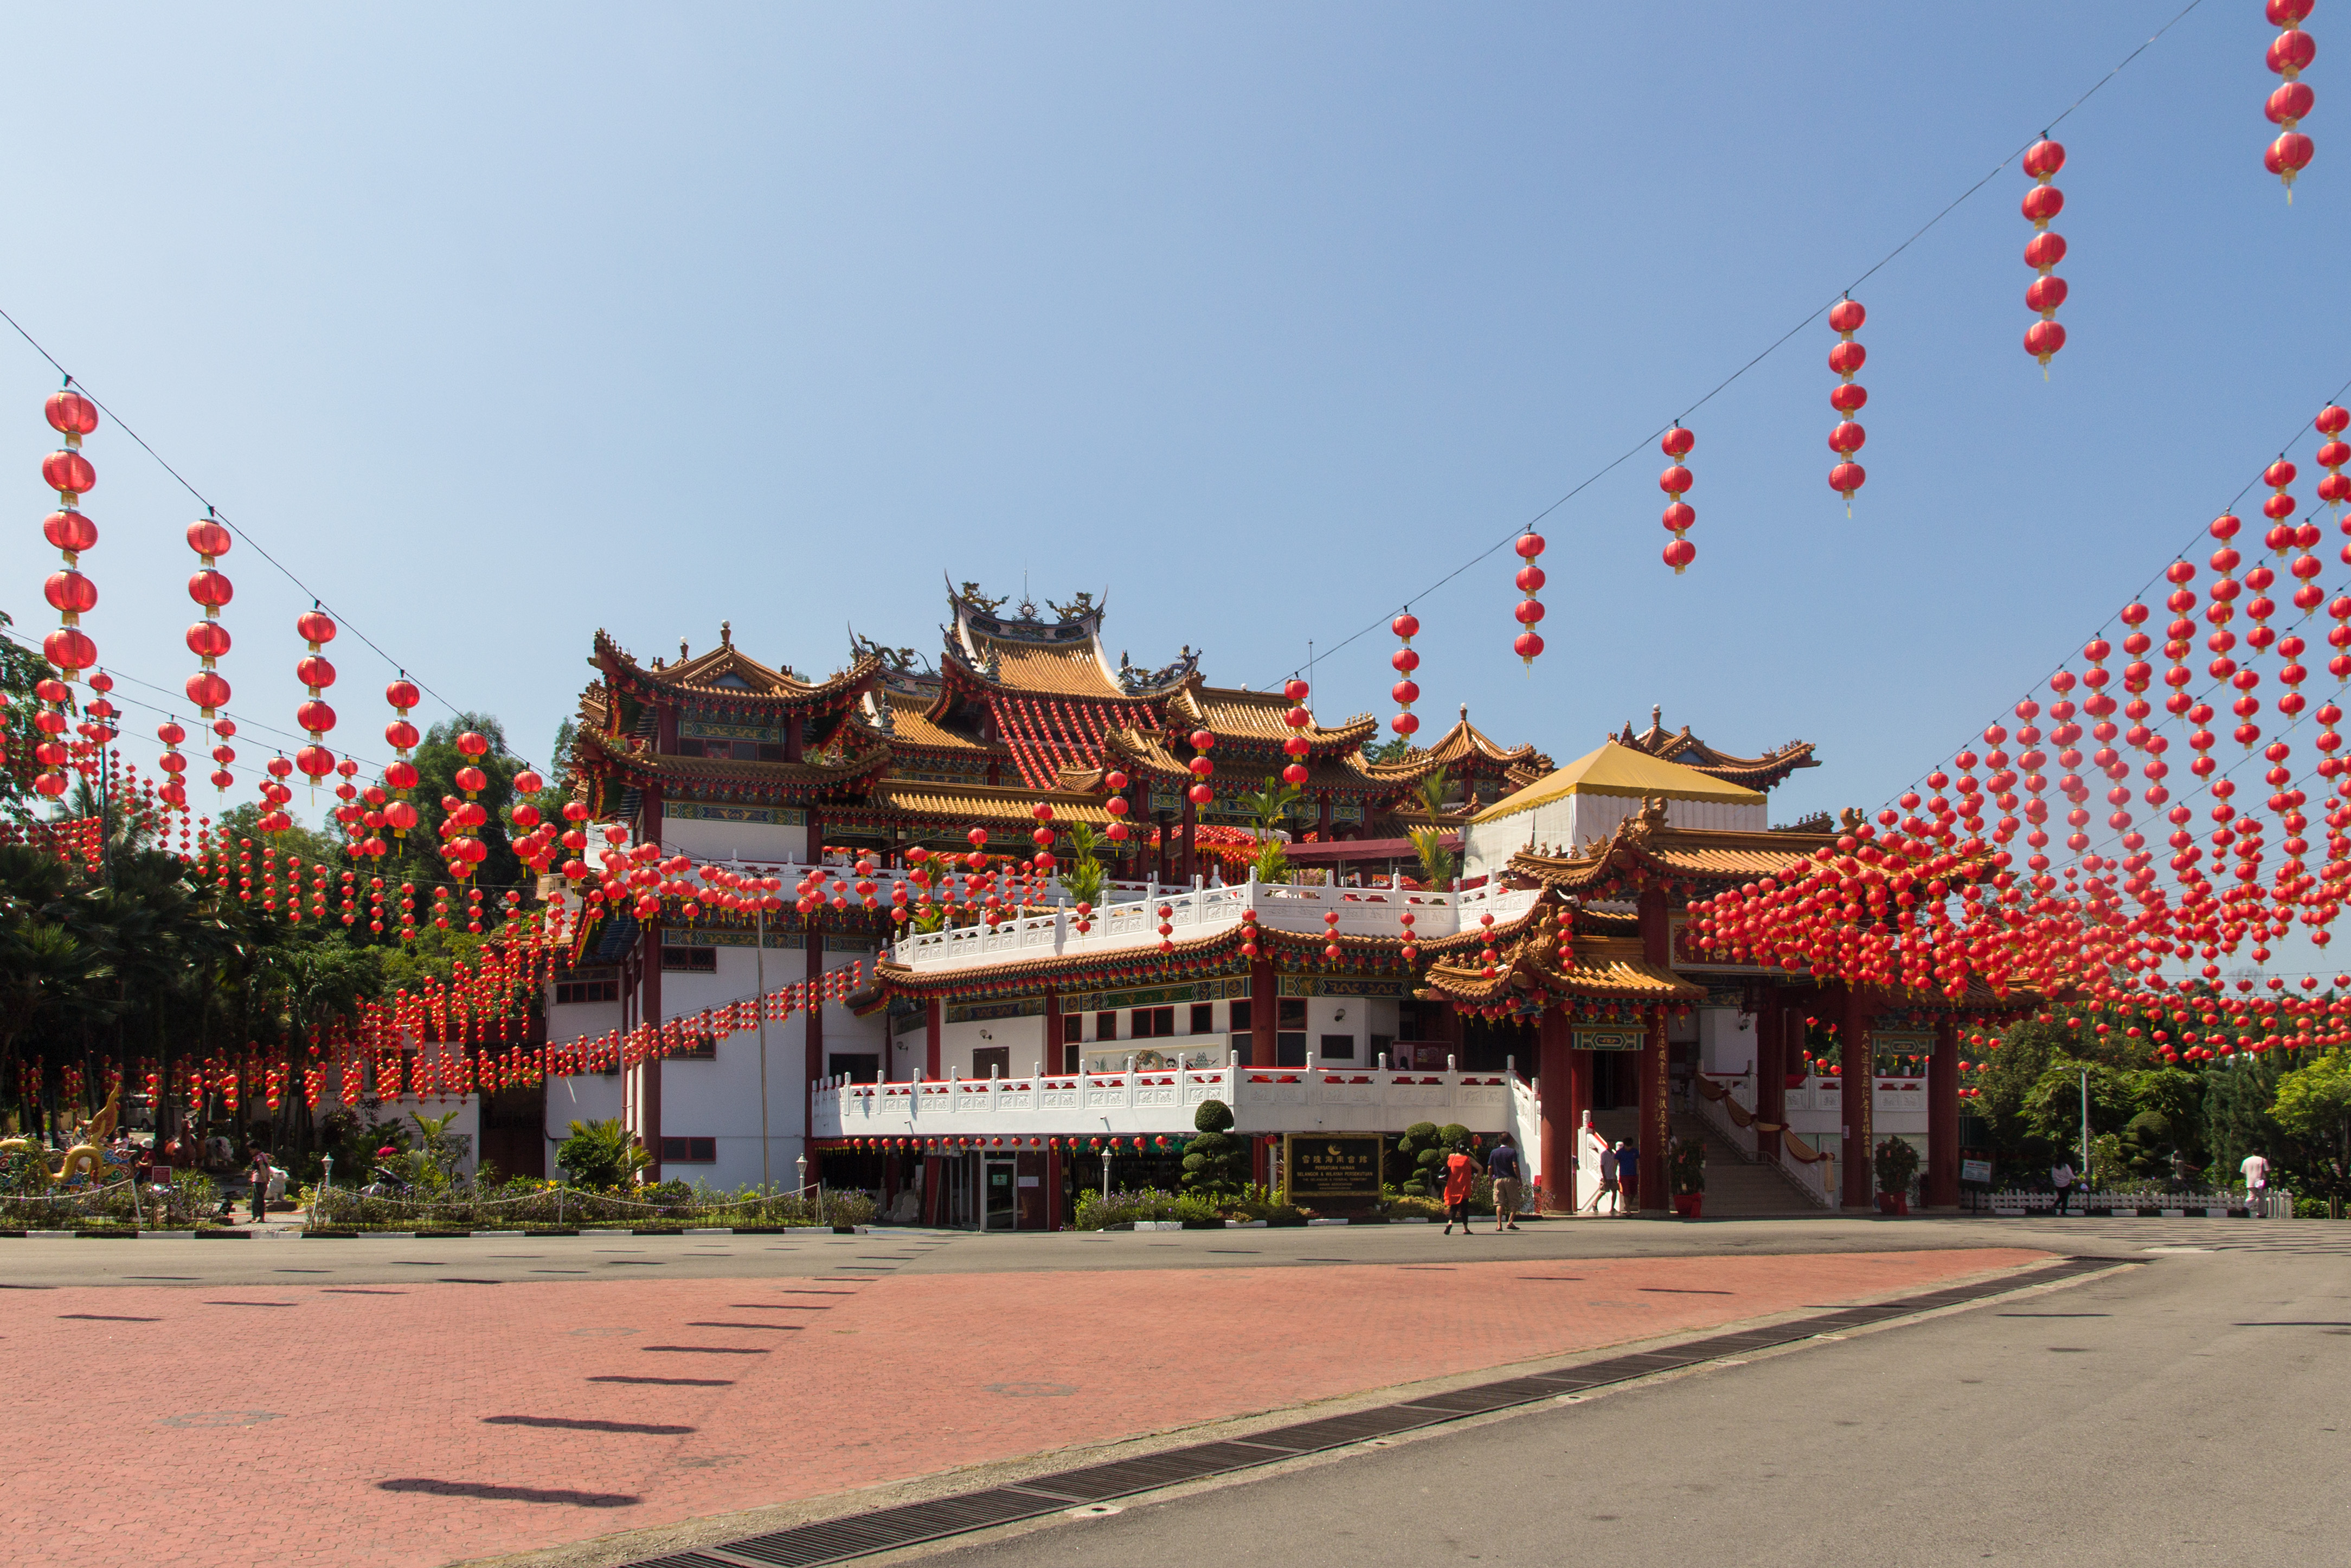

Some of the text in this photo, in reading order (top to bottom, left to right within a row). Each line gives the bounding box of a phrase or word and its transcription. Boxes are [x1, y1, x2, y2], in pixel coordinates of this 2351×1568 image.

[1302, 1155, 1367, 1164] 雪隆海南會館
